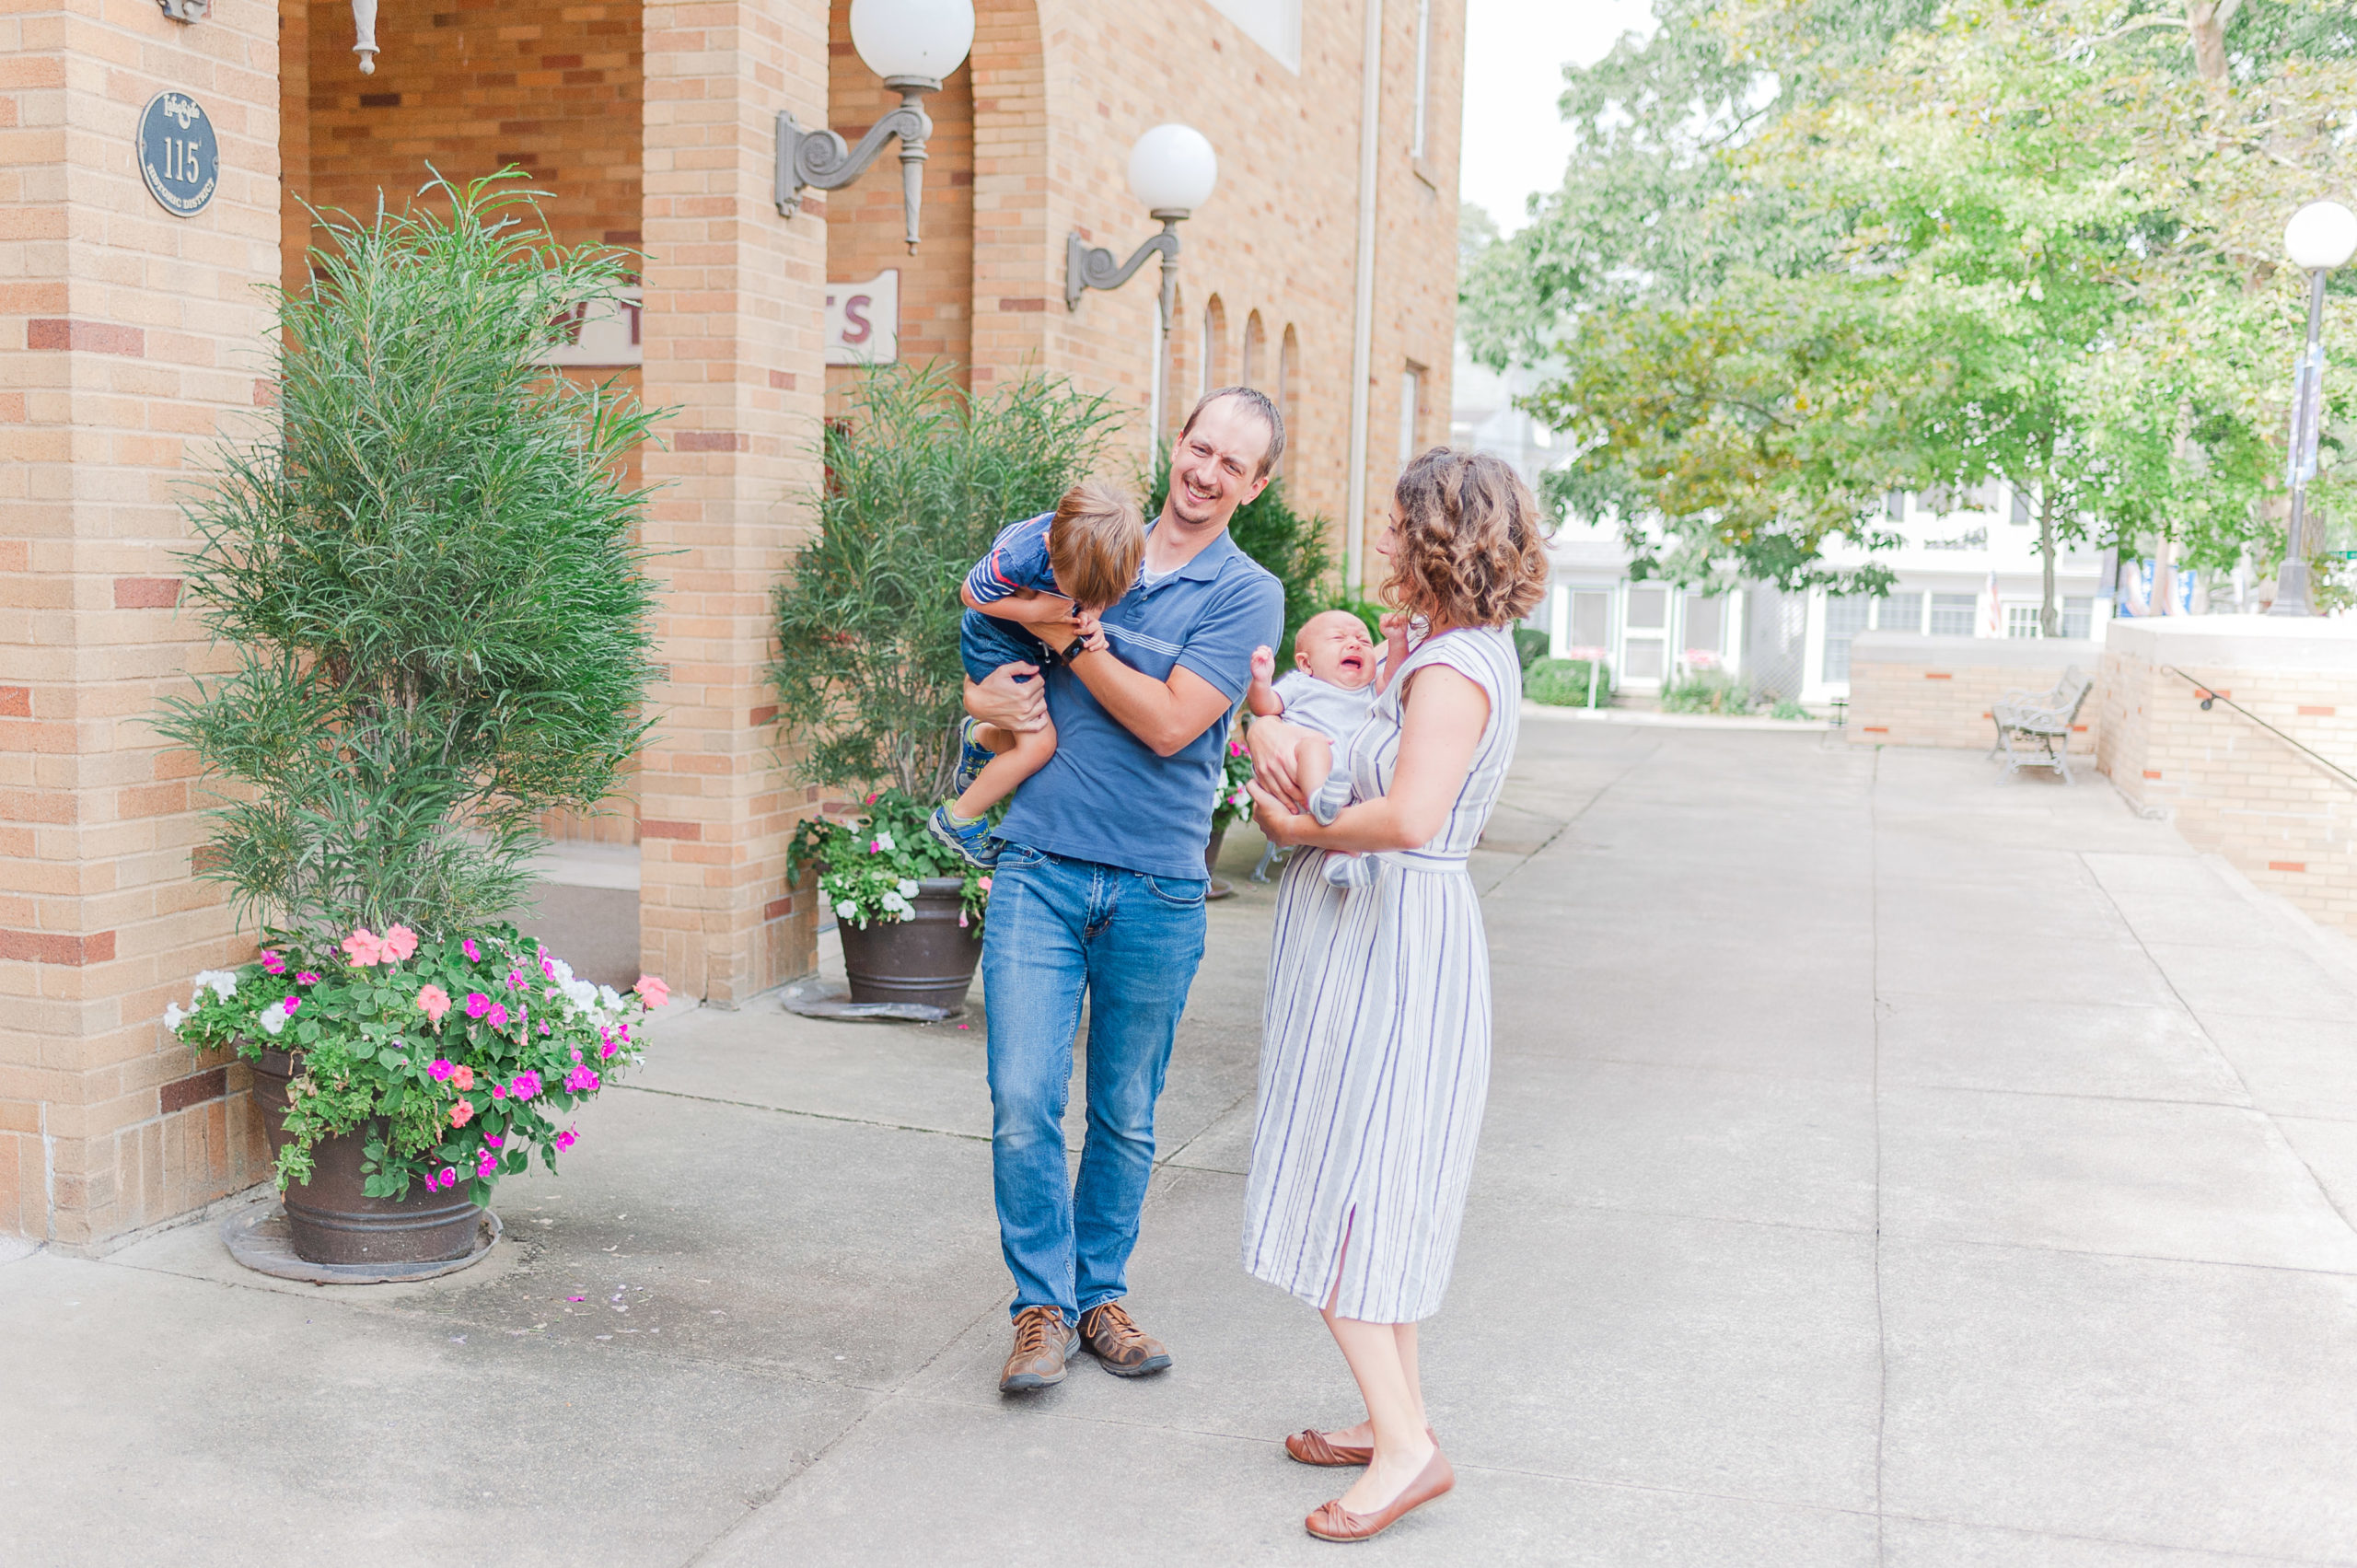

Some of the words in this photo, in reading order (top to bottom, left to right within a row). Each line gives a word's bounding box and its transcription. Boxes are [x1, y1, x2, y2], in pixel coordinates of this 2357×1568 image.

[164, 137, 199, 184] 115
[146, 163, 182, 207] HISTORIC
[183, 177, 215, 209] DISTRICT
